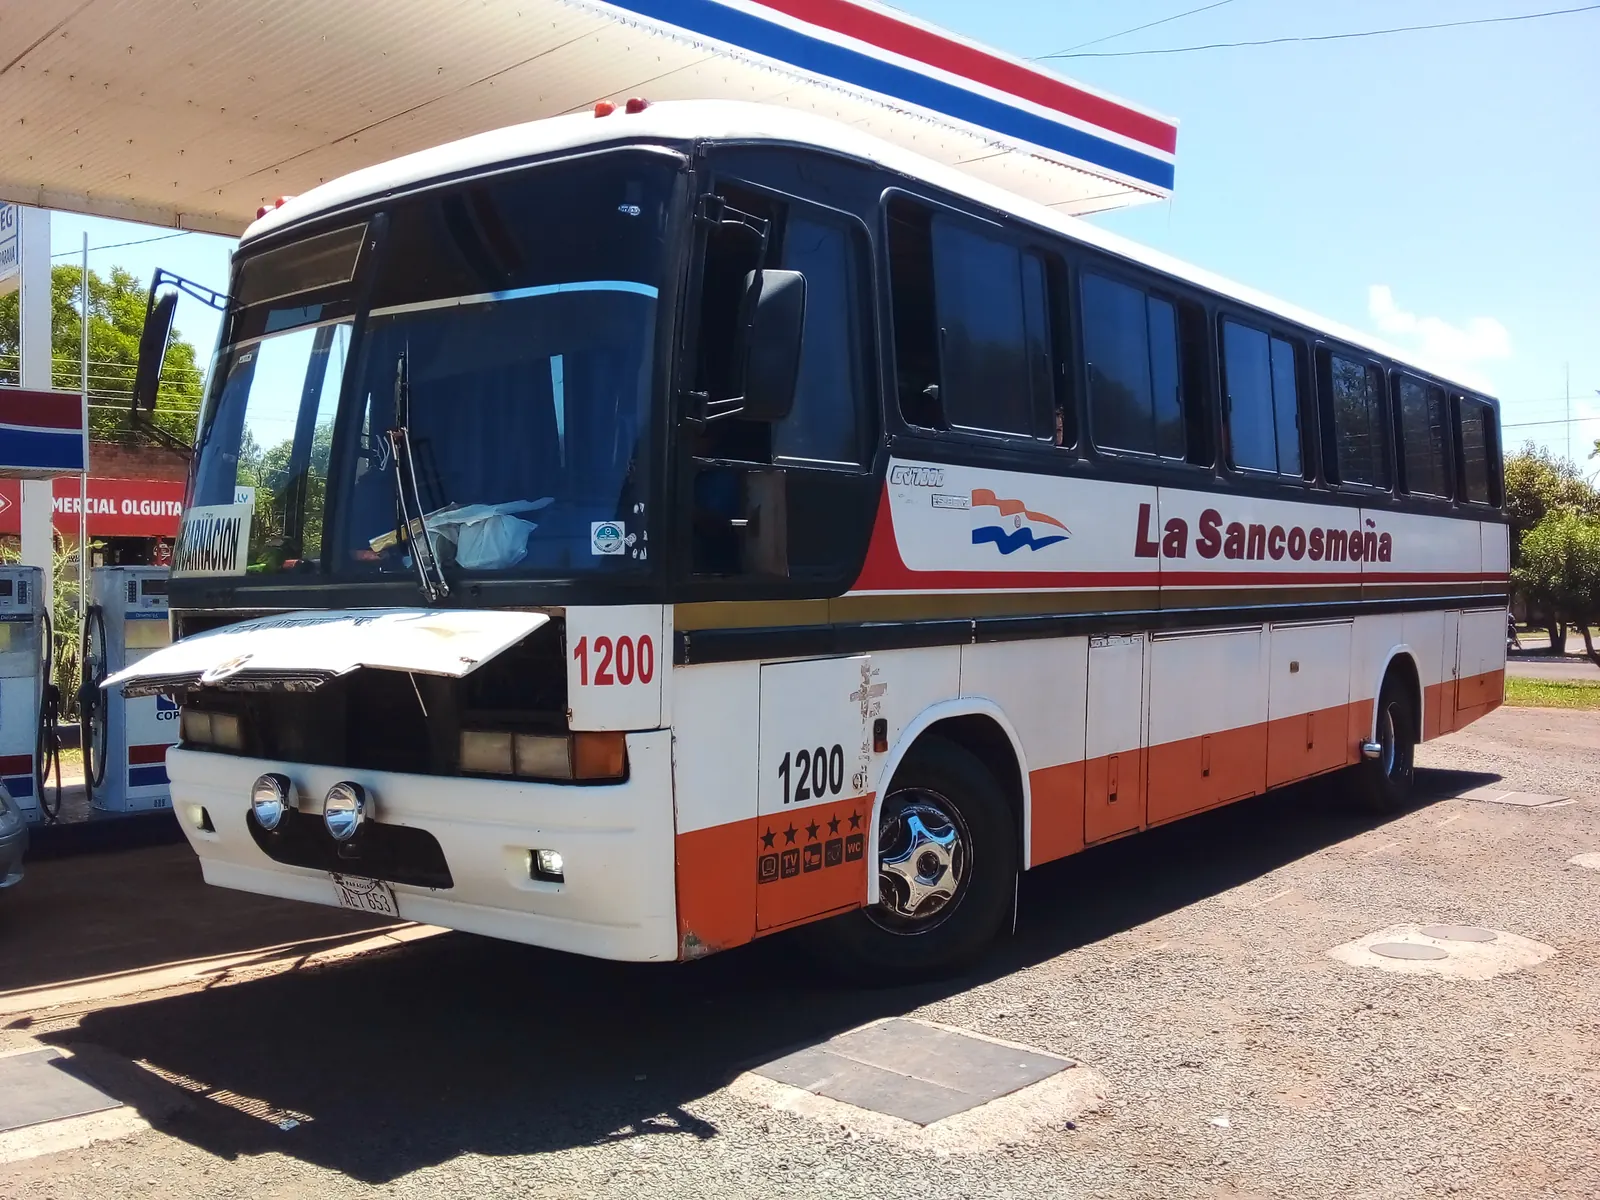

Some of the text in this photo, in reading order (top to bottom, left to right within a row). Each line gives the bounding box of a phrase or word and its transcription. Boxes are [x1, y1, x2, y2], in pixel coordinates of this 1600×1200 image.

[234, 493, 249, 503] LY
[121, 499, 182, 516] OLGUITA
[1134, 503, 1393, 563] La Sancosmeña
[573, 634, 654, 686] 1200
[778, 744, 844, 804] 1200
[847, 842, 861, 854] WC
[783, 853, 798, 869] TV
[366, 893, 391, 912] 653
